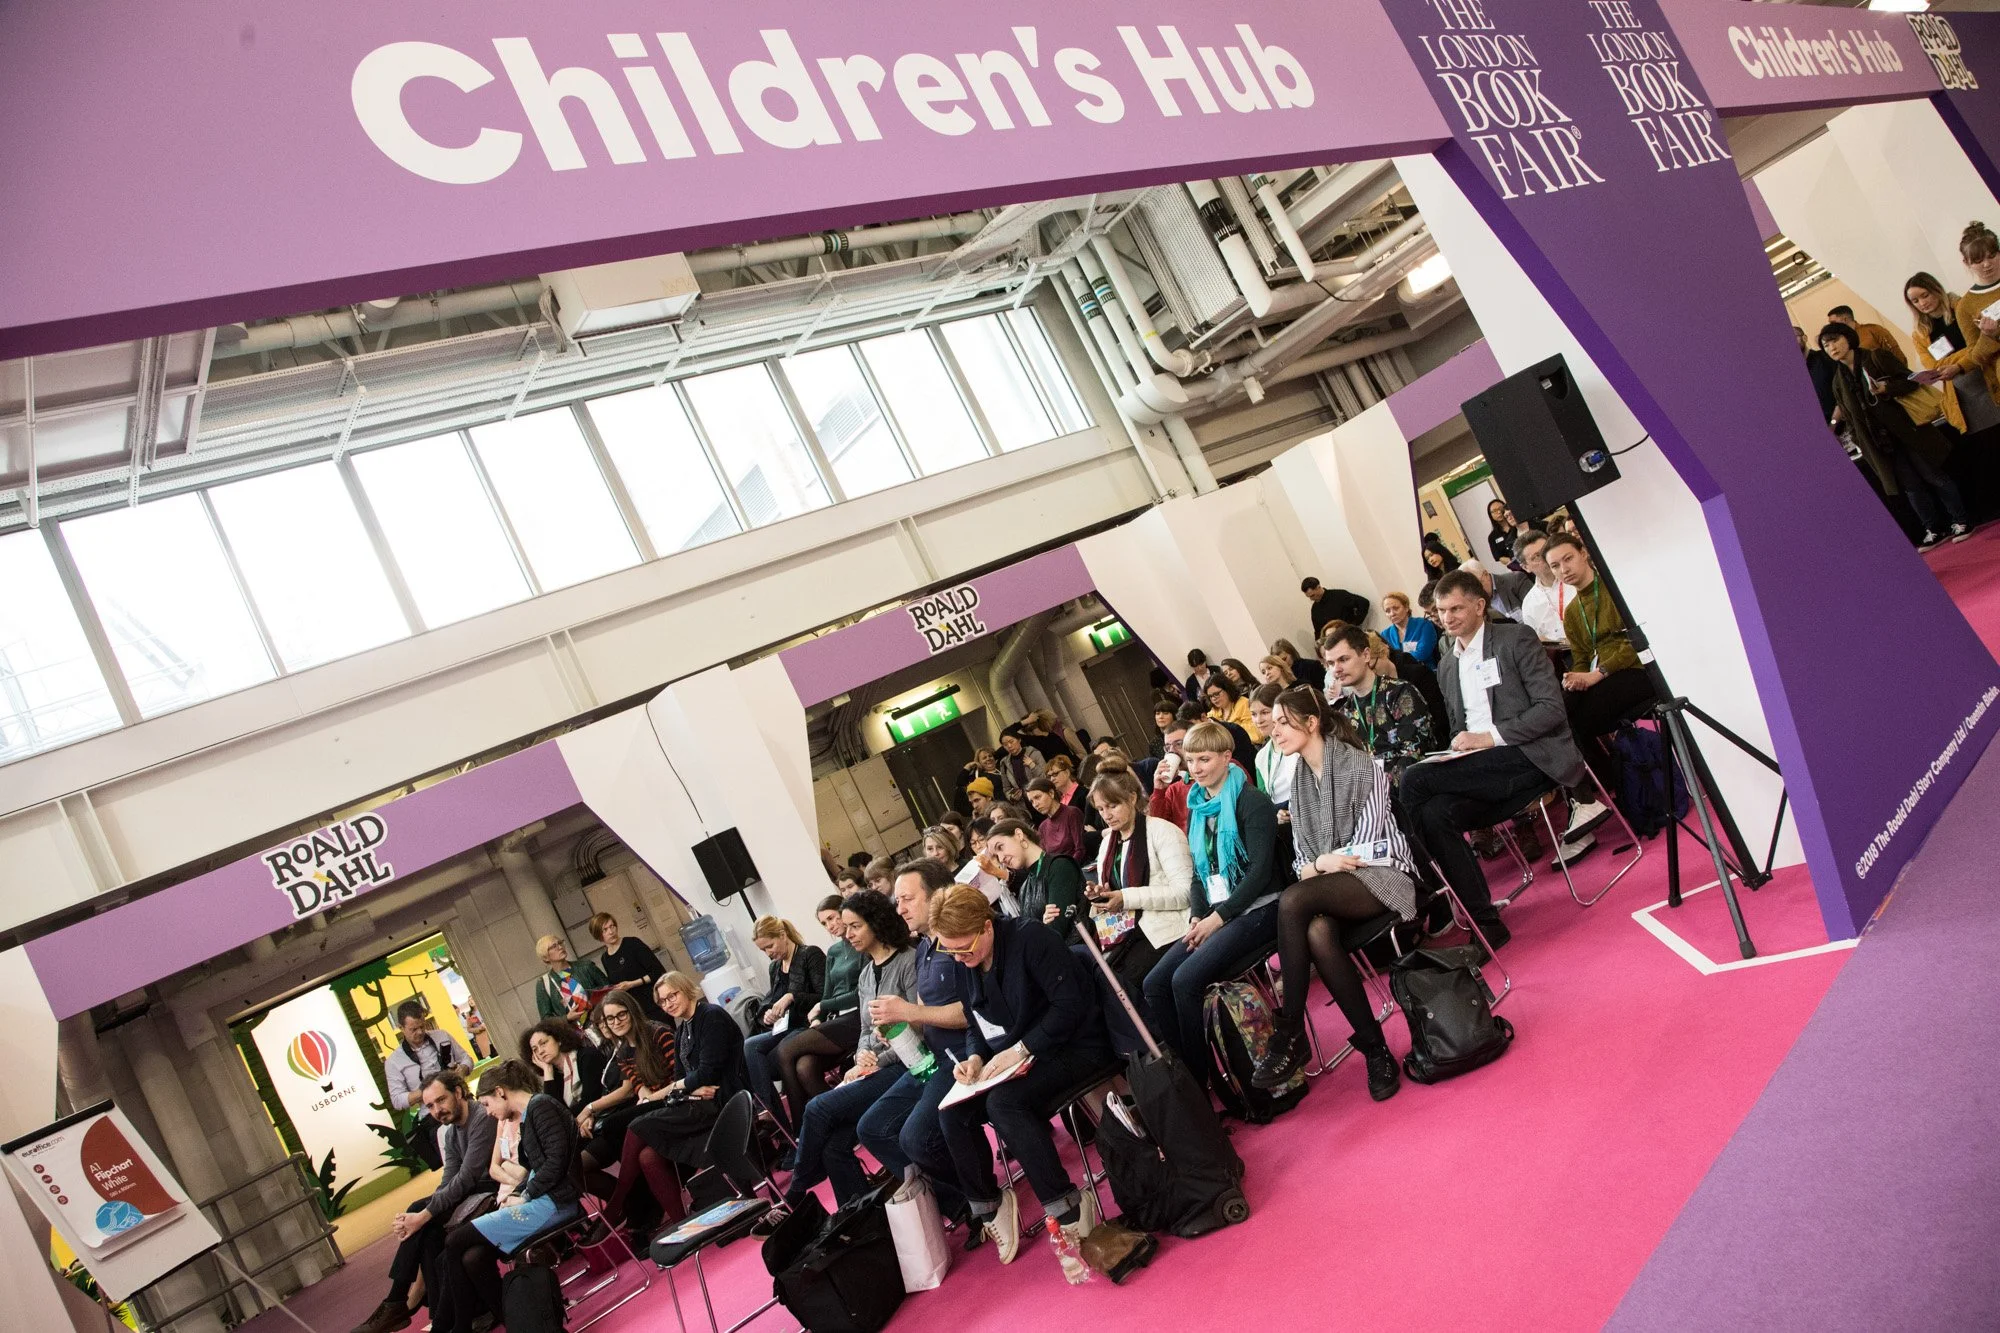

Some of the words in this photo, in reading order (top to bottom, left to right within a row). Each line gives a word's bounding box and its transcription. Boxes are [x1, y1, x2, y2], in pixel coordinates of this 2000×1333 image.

[1425, 0, 1496, 30] THE
[1588, 1, 1642, 29] THE
[1586, 31, 1677, 62] LONDON
[1908, 16, 1960, 51] ROALD
[1418, 34, 1539, 69] LONDON
[1728, 26, 1862, 79] Children's
[1848, 30, 1903, 73] Hub
[1929, 53, 1977, 87] DAHL
[351, 26, 1125, 185] Children's
[1116, 24, 1315, 118] Hub
[1437, 70, 1573, 132] BOOK
[1602, 61, 1705, 115] BOOK
[908, 586, 978, 630] ROALD
[923, 613, 985, 652] DAHL
[1874, 832, 1890, 851] The
[1886, 803, 1908, 836] Roald
[1903, 786, 1921, 813] Dahl
[1916, 769, 1935, 796] Story
[1930, 738, 1959, 775] Company
[1954, 724, 1967, 745] Ltd
[265, 815, 385, 886] ROALD
[286, 852, 391, 916] DAHL
[311, 1085, 357, 1112] USBORNE
[89, 1162, 102, 1174] A1
[94, 1158, 134, 1182] Flipchart
[101, 1175, 129, 1191] White
